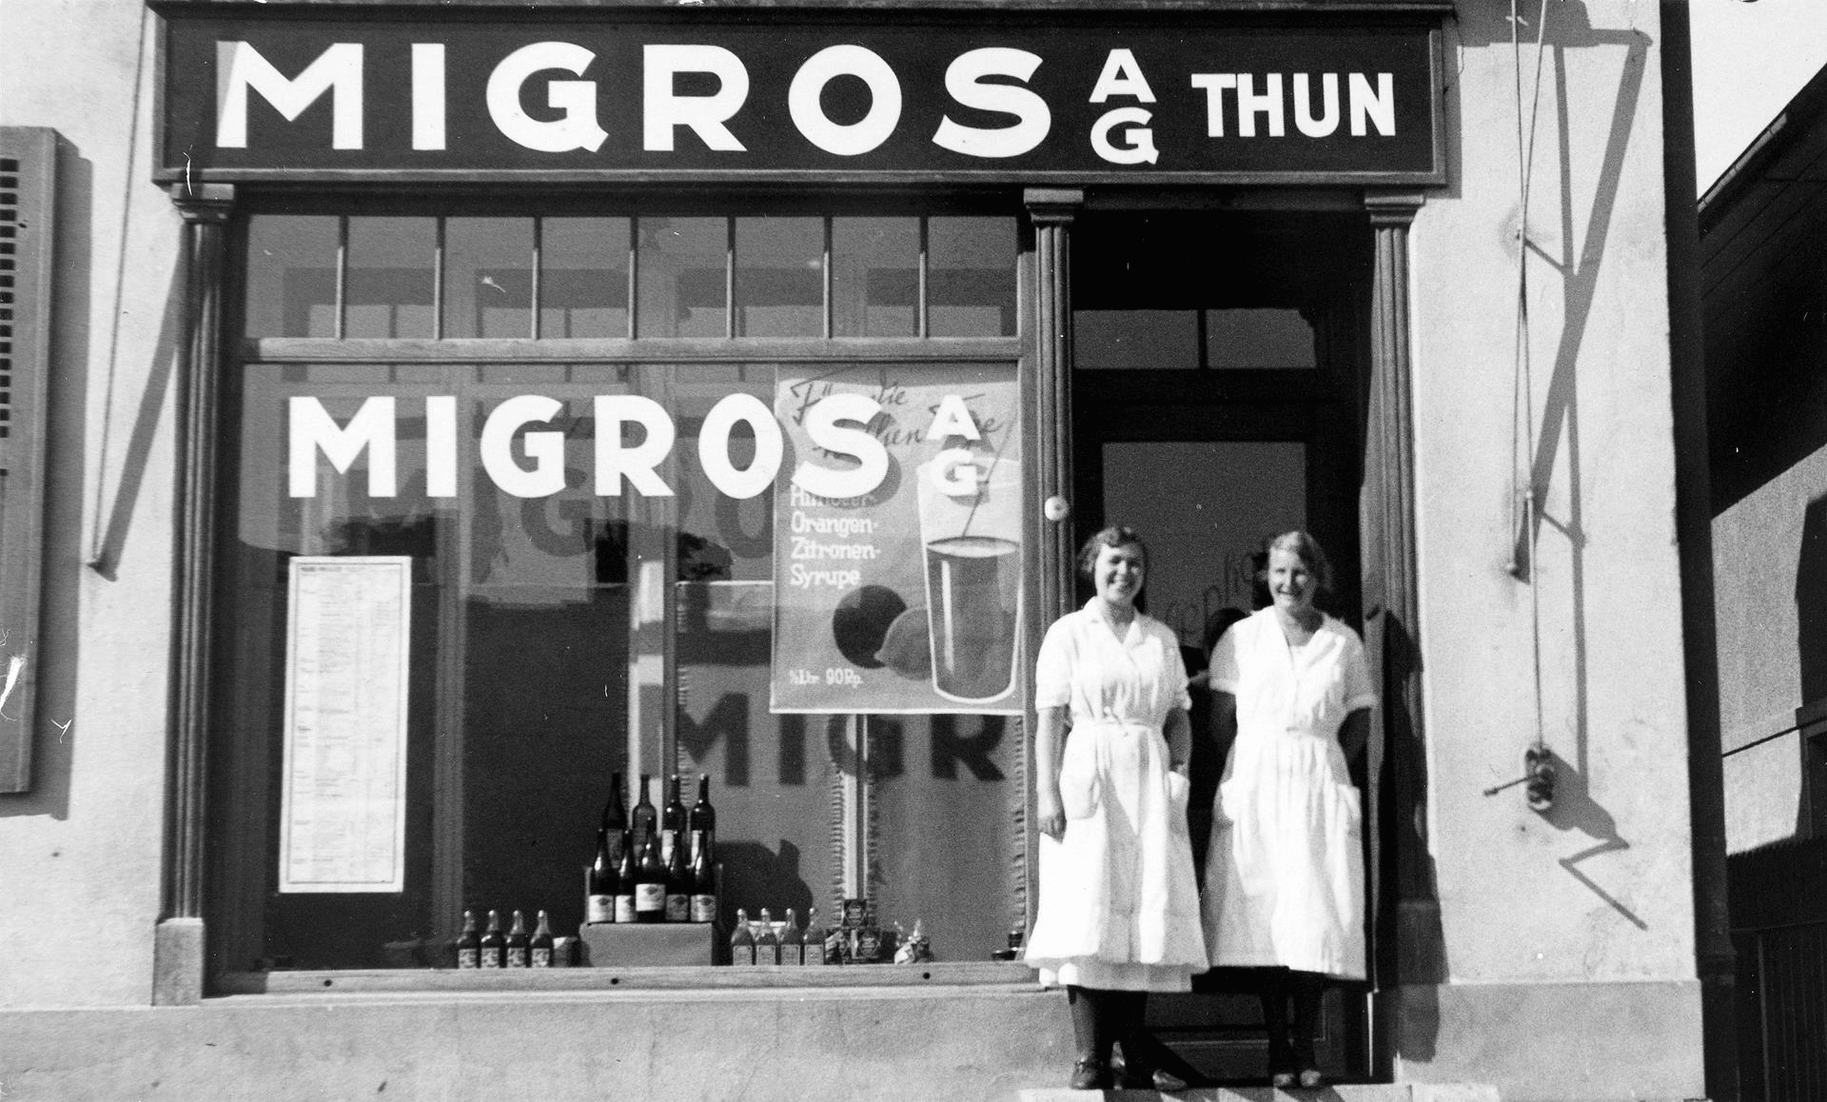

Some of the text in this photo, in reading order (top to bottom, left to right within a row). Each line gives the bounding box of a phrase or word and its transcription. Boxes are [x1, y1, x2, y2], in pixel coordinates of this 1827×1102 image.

[216, 40, 1053, 158] MIGROS
[1190, 72, 1397, 139] THUN
[288, 391, 889, 499] MIGROS
[790, 563, 861, 590] Syrupe
